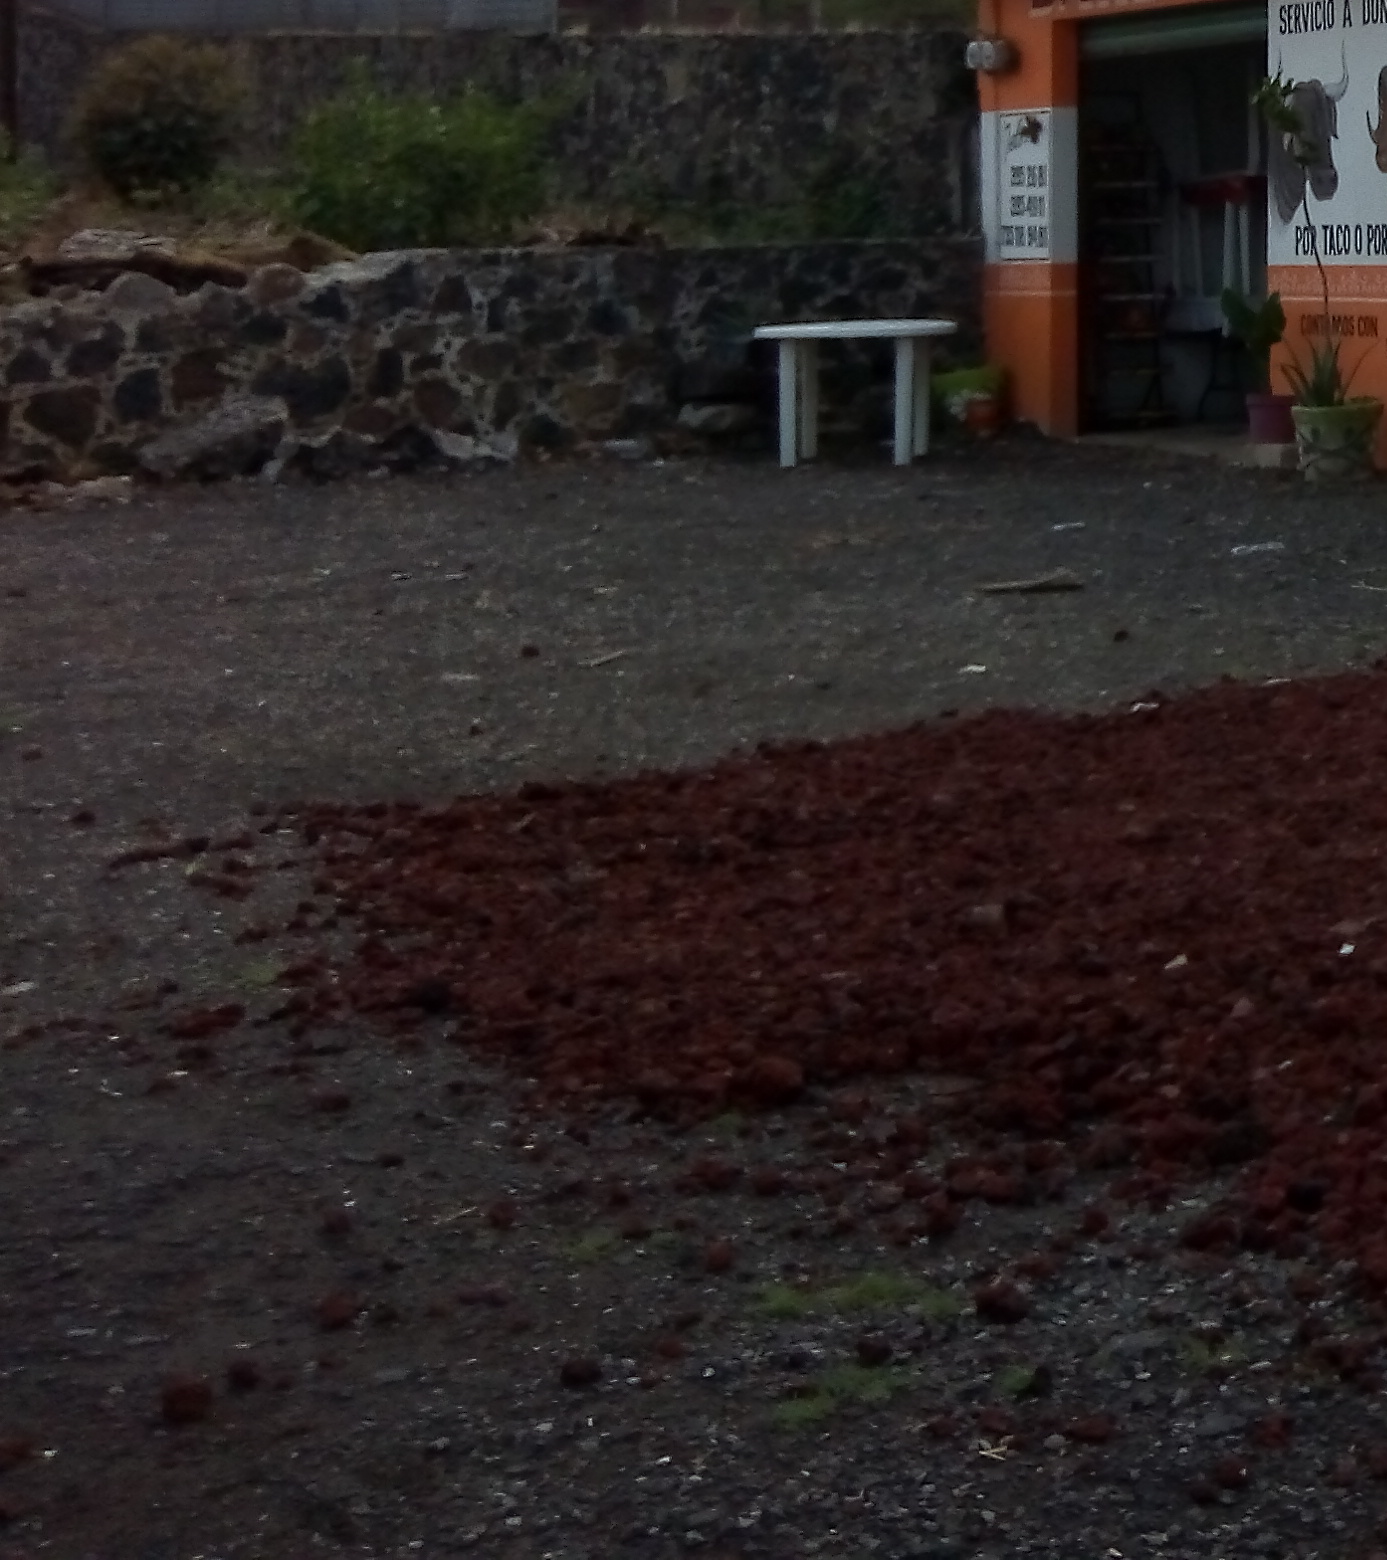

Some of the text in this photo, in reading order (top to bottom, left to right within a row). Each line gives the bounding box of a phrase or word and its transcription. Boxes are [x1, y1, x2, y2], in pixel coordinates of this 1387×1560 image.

[1279, 0, 1335, 36] SERVICIO
[1295, 224, 1317, 257] POR
[1321, 224, 1351, 256] TACO
[1354, 224, 1363, 256] O
[1357, 314, 1379, 338] CON
